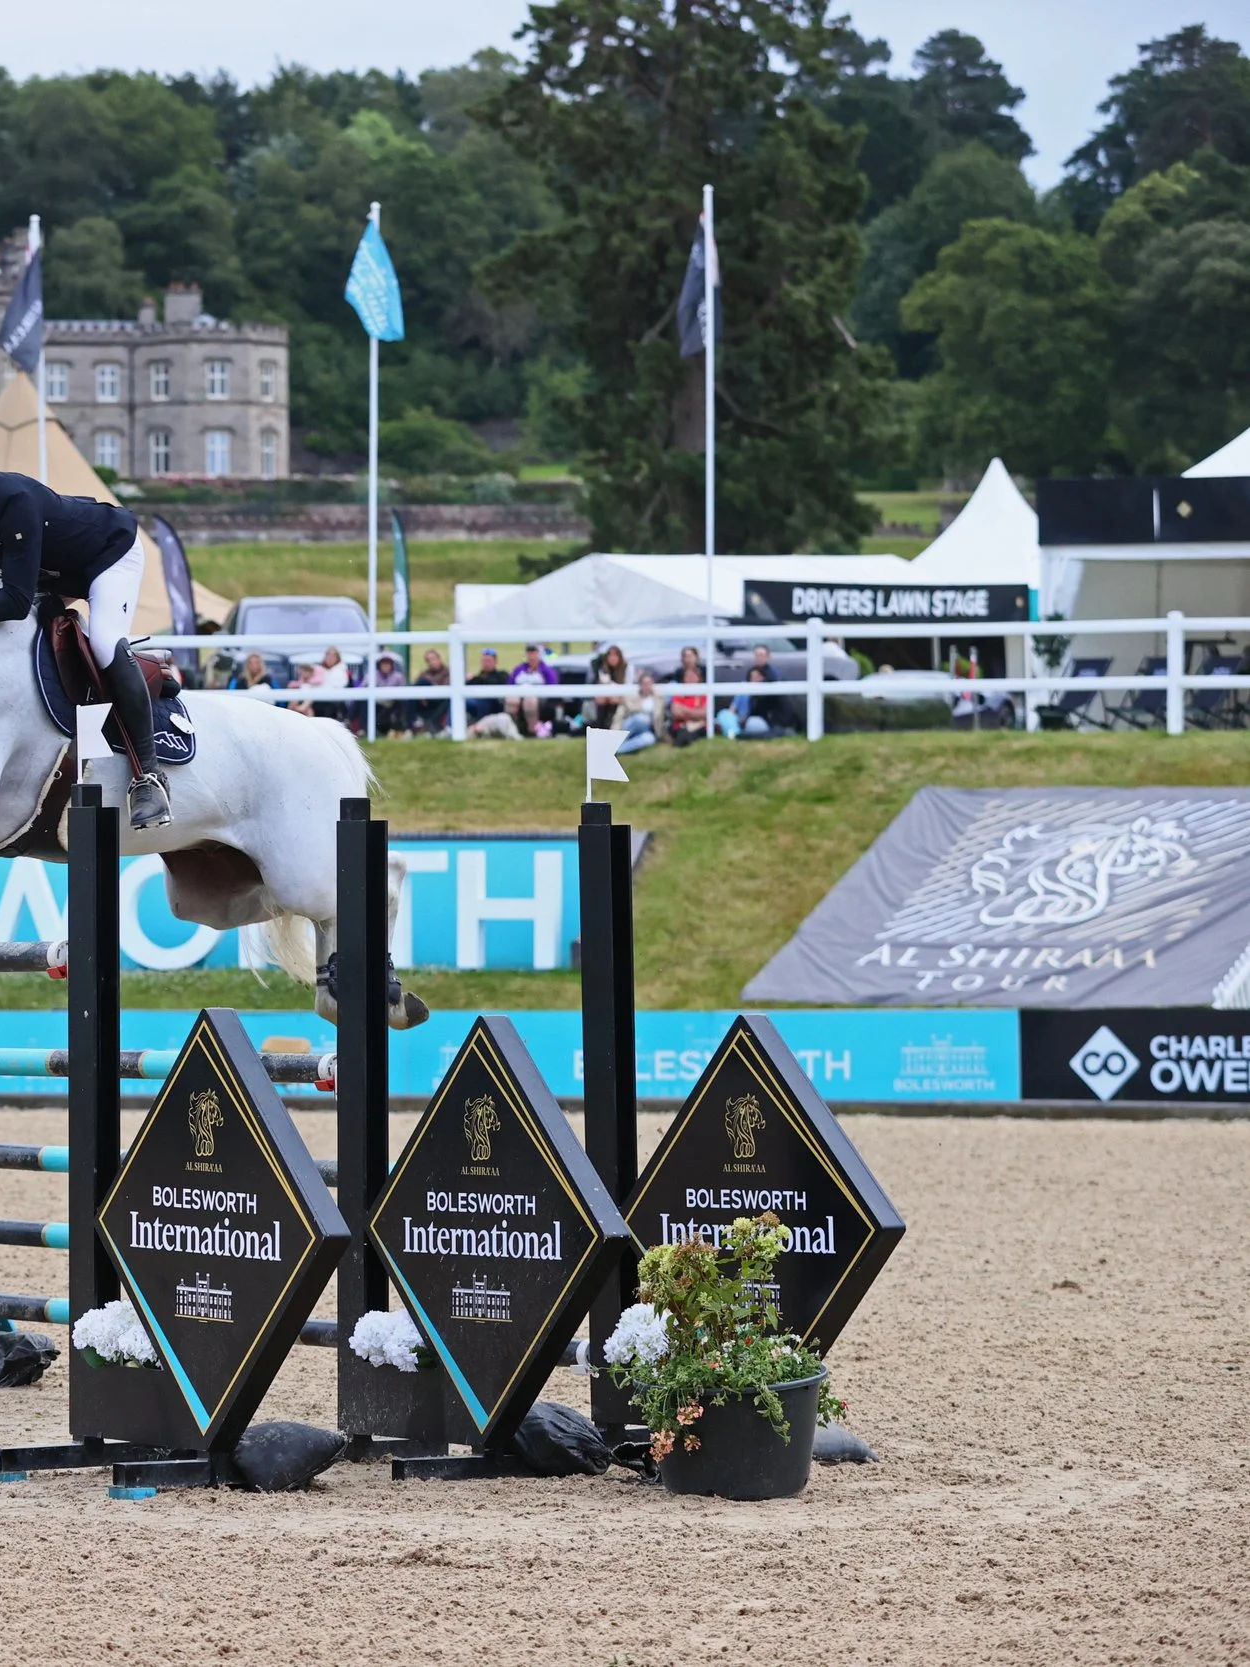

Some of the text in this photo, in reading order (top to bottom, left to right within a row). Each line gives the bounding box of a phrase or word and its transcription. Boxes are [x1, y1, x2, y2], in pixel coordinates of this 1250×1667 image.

[792, 587, 989, 617] DRIVERS LAWN STAGE
[855, 942, 921, 967] AL
[915, 970, 1069, 992] TOUR
[1149, 1059, 1250, 1093] OWE
[185, 1161, 193, 1171] AL
[460, 1166, 470, 1175] AL
[723, 1163, 732, 1172] AL
[152, 1186, 257, 1215] BOLESWORTH
[426, 1191, 536, 1216] BOLESWORTH
[686, 1188, 807, 1211] BOLESWORTH
[129, 1210, 281, 1261] International
[403, 1216, 562, 1261] International
